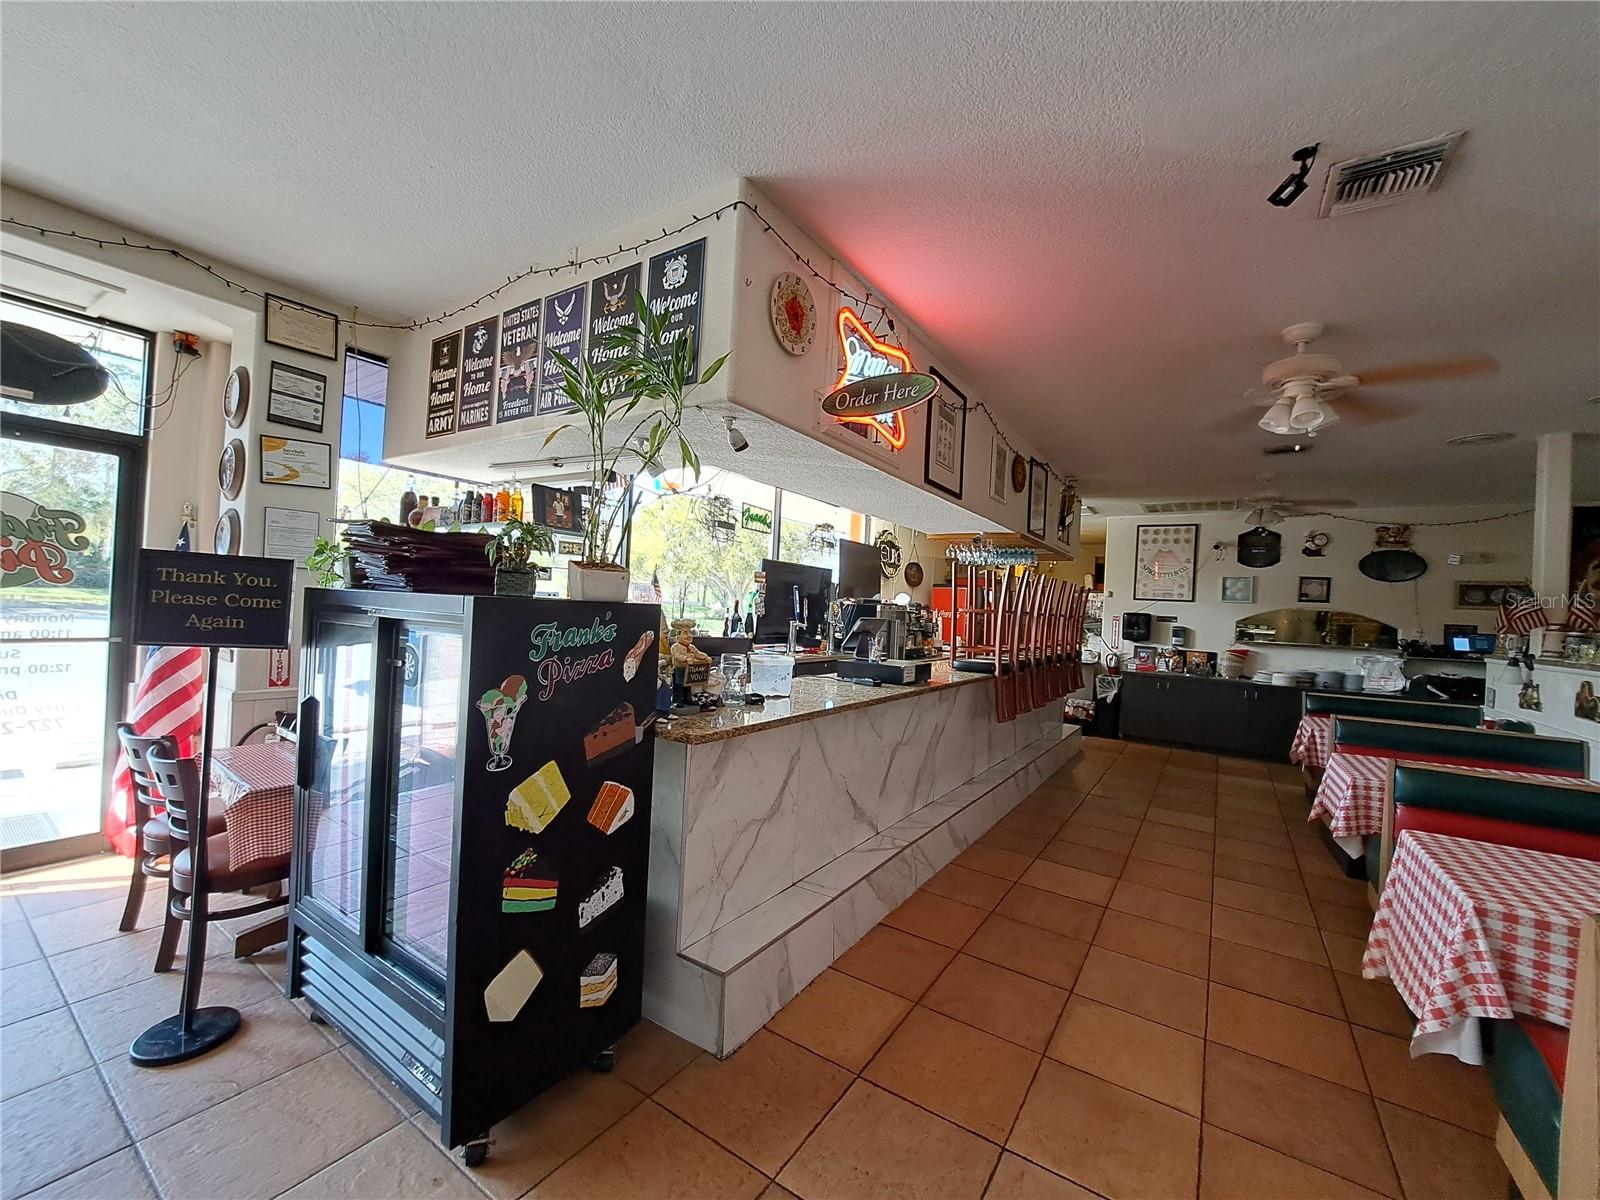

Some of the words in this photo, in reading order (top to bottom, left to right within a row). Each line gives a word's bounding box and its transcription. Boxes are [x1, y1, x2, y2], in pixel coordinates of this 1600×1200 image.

[504, 311, 521, 329] UNITED
[521, 304, 539, 322] STATES
[592, 312, 635, 336] Welcome
[503, 321, 538, 347] VETERAN
[544, 328, 581, 348] Welcome
[591, 345, 631, 364] Home
[463, 356, 494, 373] Welcome
[431, 367, 458, 383] Welcome
[430, 391, 455, 406] Home
[463, 381, 491, 397] Home
[835, 387, 880, 410] Order
[884, 382, 920, 402] Here
[503, 397, 529, 410] Freedom
[540, 391, 552, 409] AIR
[460, 406, 489, 425] MARINES
[504, 407, 519, 417] NEVER
[520, 404, 533, 414] FREE
[427, 414, 454, 433] ARMY
[155, 567, 227, 585] Thank
[233, 571, 278, 588] You.
[151, 589, 218, 606] Please
[225, 593, 283, 609] Come
[185, 613, 245, 632] Again
[529, 610, 618, 662] Frank's
[537, 648, 616, 702] Pizza
